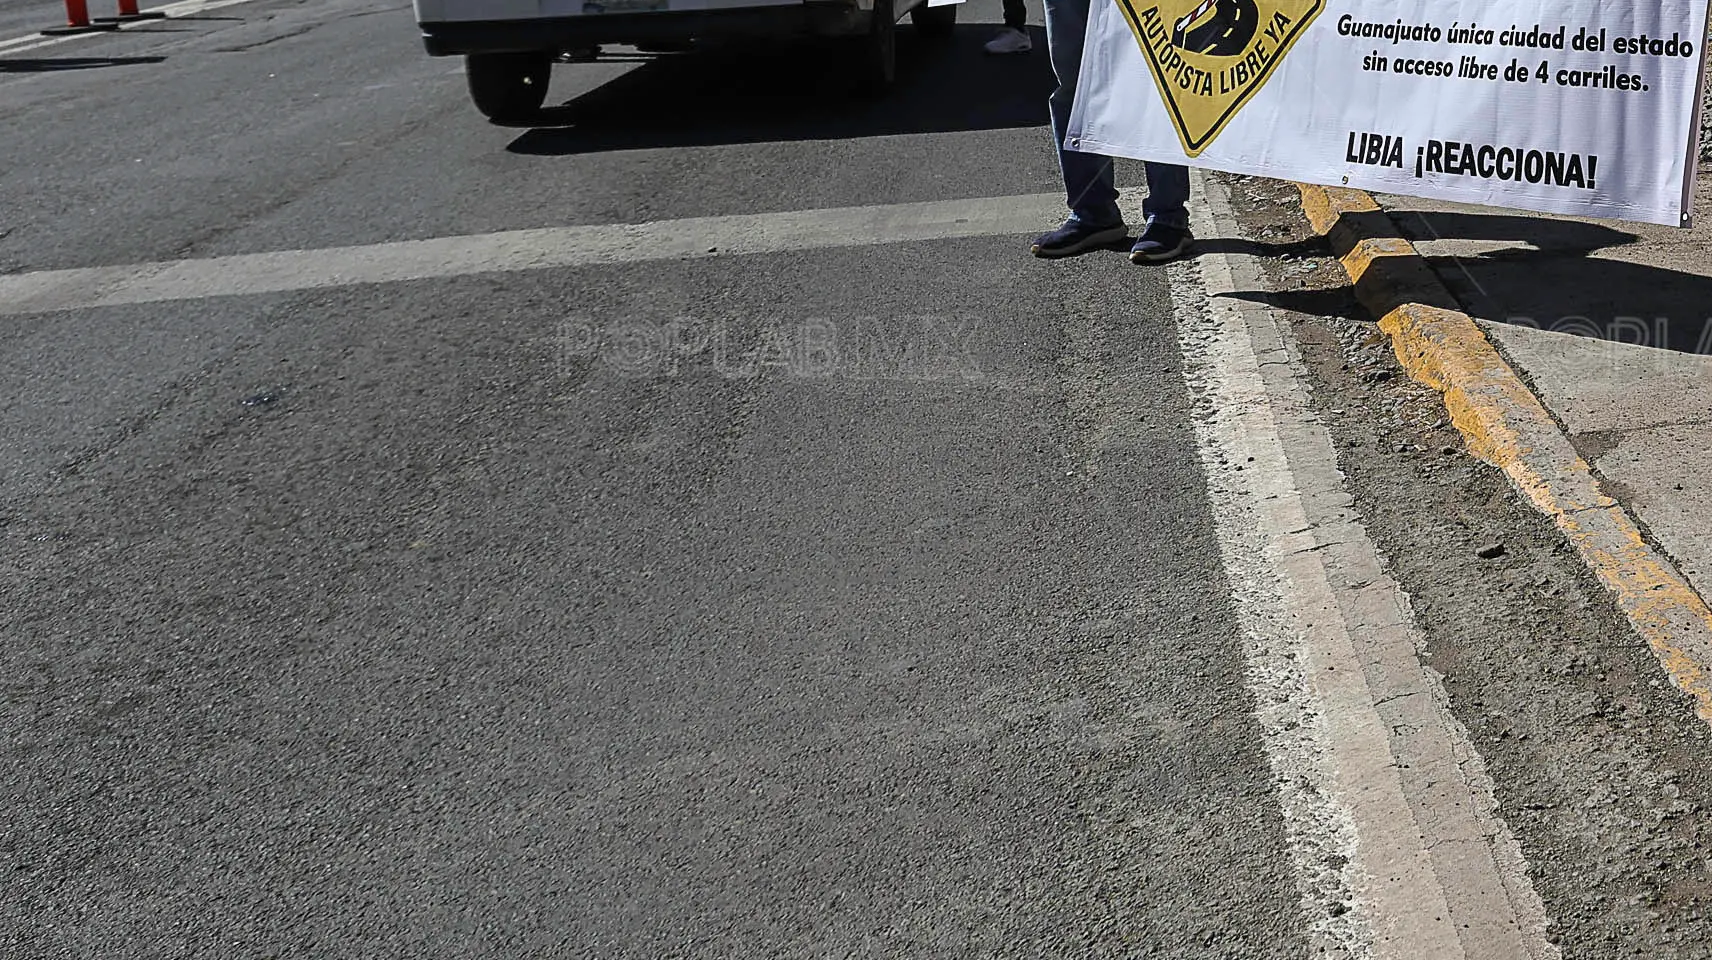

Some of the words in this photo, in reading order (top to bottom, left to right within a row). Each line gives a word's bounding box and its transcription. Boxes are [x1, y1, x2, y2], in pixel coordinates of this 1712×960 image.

[1141, 5, 1214, 96] AUTOPISTA
[1219, 46, 1269, 96] LIBRE
[1266, 10, 1292, 48] YA
[1338, 14, 1441, 44] Guanajuato
[1447, 22, 1494, 45] única
[1499, 25, 1565, 49] ciudad
[1572, 27, 1605, 51] del
[1613, 32, 1693, 57] estado
[1363, 50, 1387, 71] sin
[1394, 58, 1453, 77] acceso
[1458, 56, 1498, 80] libre
[1504, 59, 1528, 82] de
[1535, 61, 1548, 83] 4
[1556, 65, 1648, 91] carriles.
[1346, 132, 1403, 168] LIBIA
[1415, 140, 1597, 189] ¡REACCIONA!
